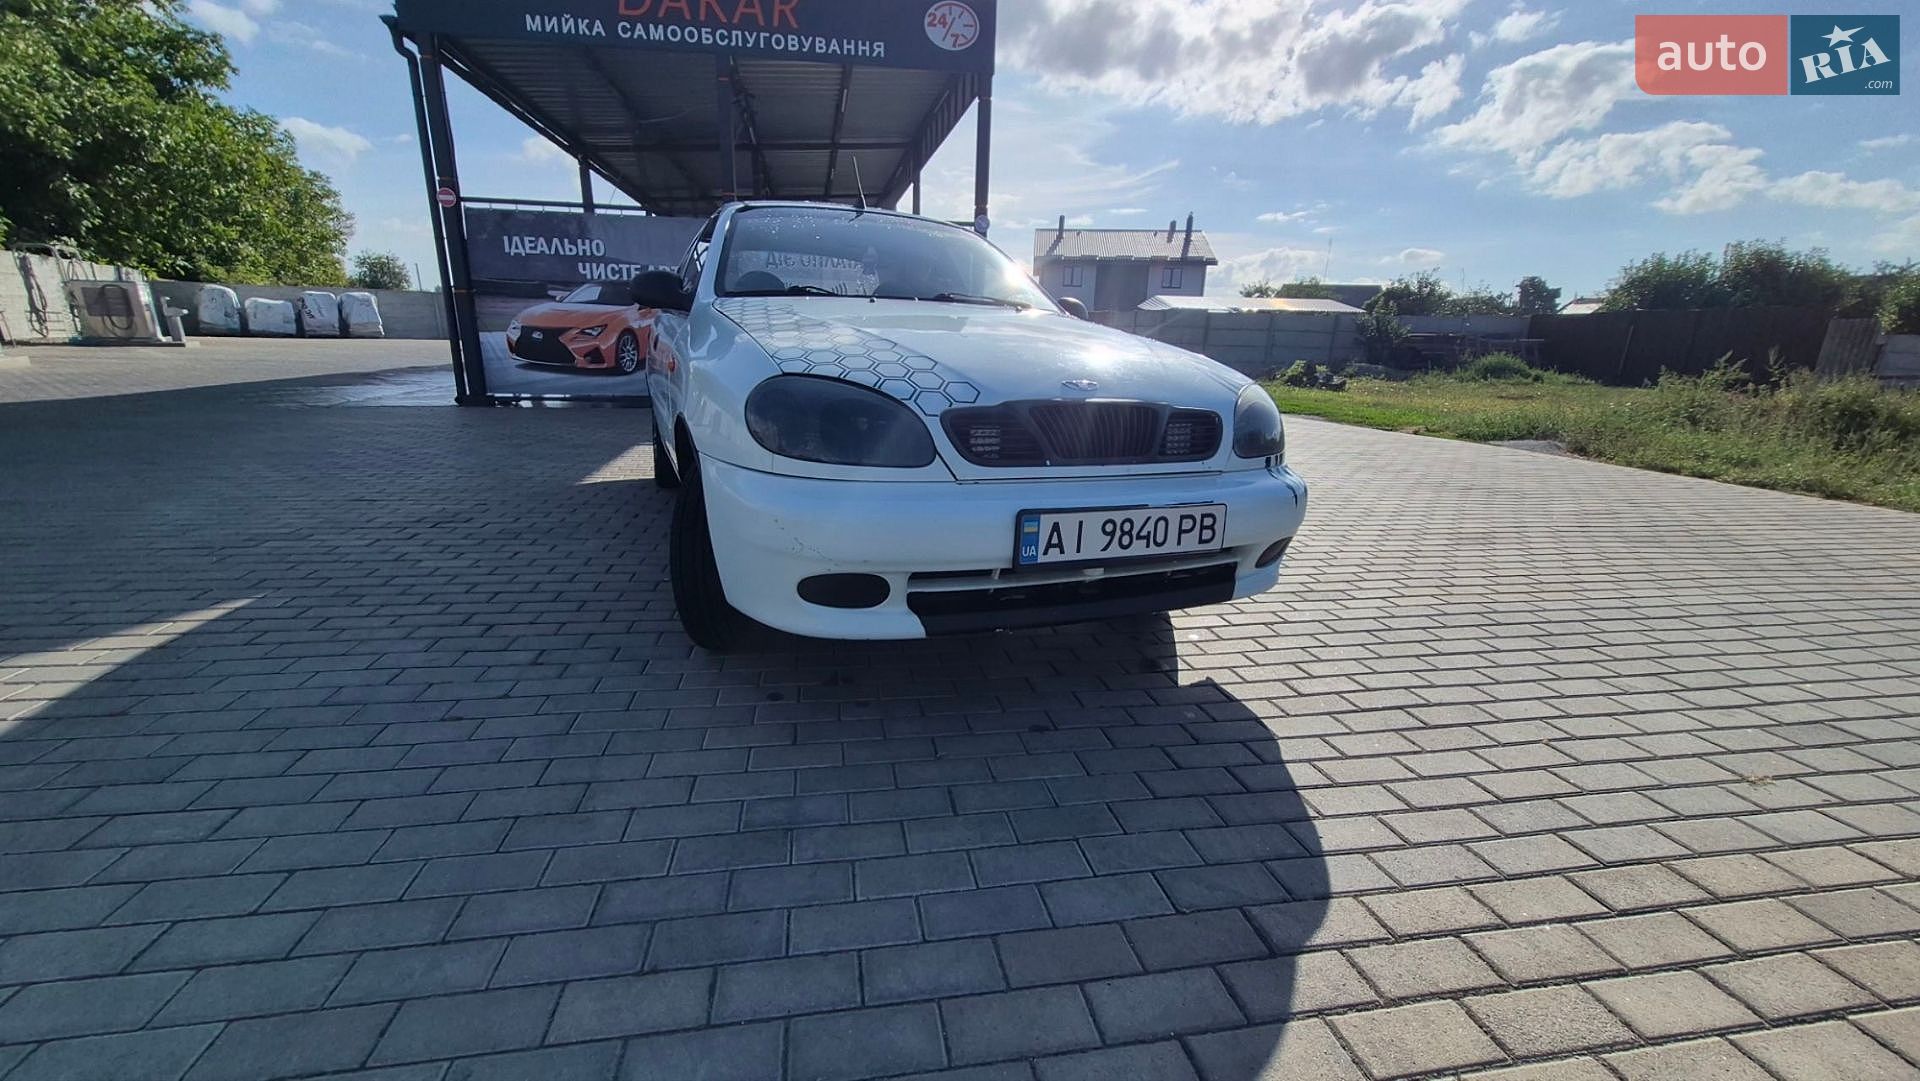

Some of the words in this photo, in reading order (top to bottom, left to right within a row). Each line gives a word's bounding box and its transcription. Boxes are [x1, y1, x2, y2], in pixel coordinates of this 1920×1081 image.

[525, 13, 607, 37] МИЙКА
[617, 21, 885, 58] САМООБСЛУГОВУВАННЯ
[503, 235, 605, 257] ІДЕАЛЬНО
[577, 262, 641, 281] ЧИСТЕ
[1022, 546, 1037, 557] UA
[1042, 519, 1083, 556] AI
[1100, 515, 1169, 552] 9840
[1176, 512, 1218, 546] PB
